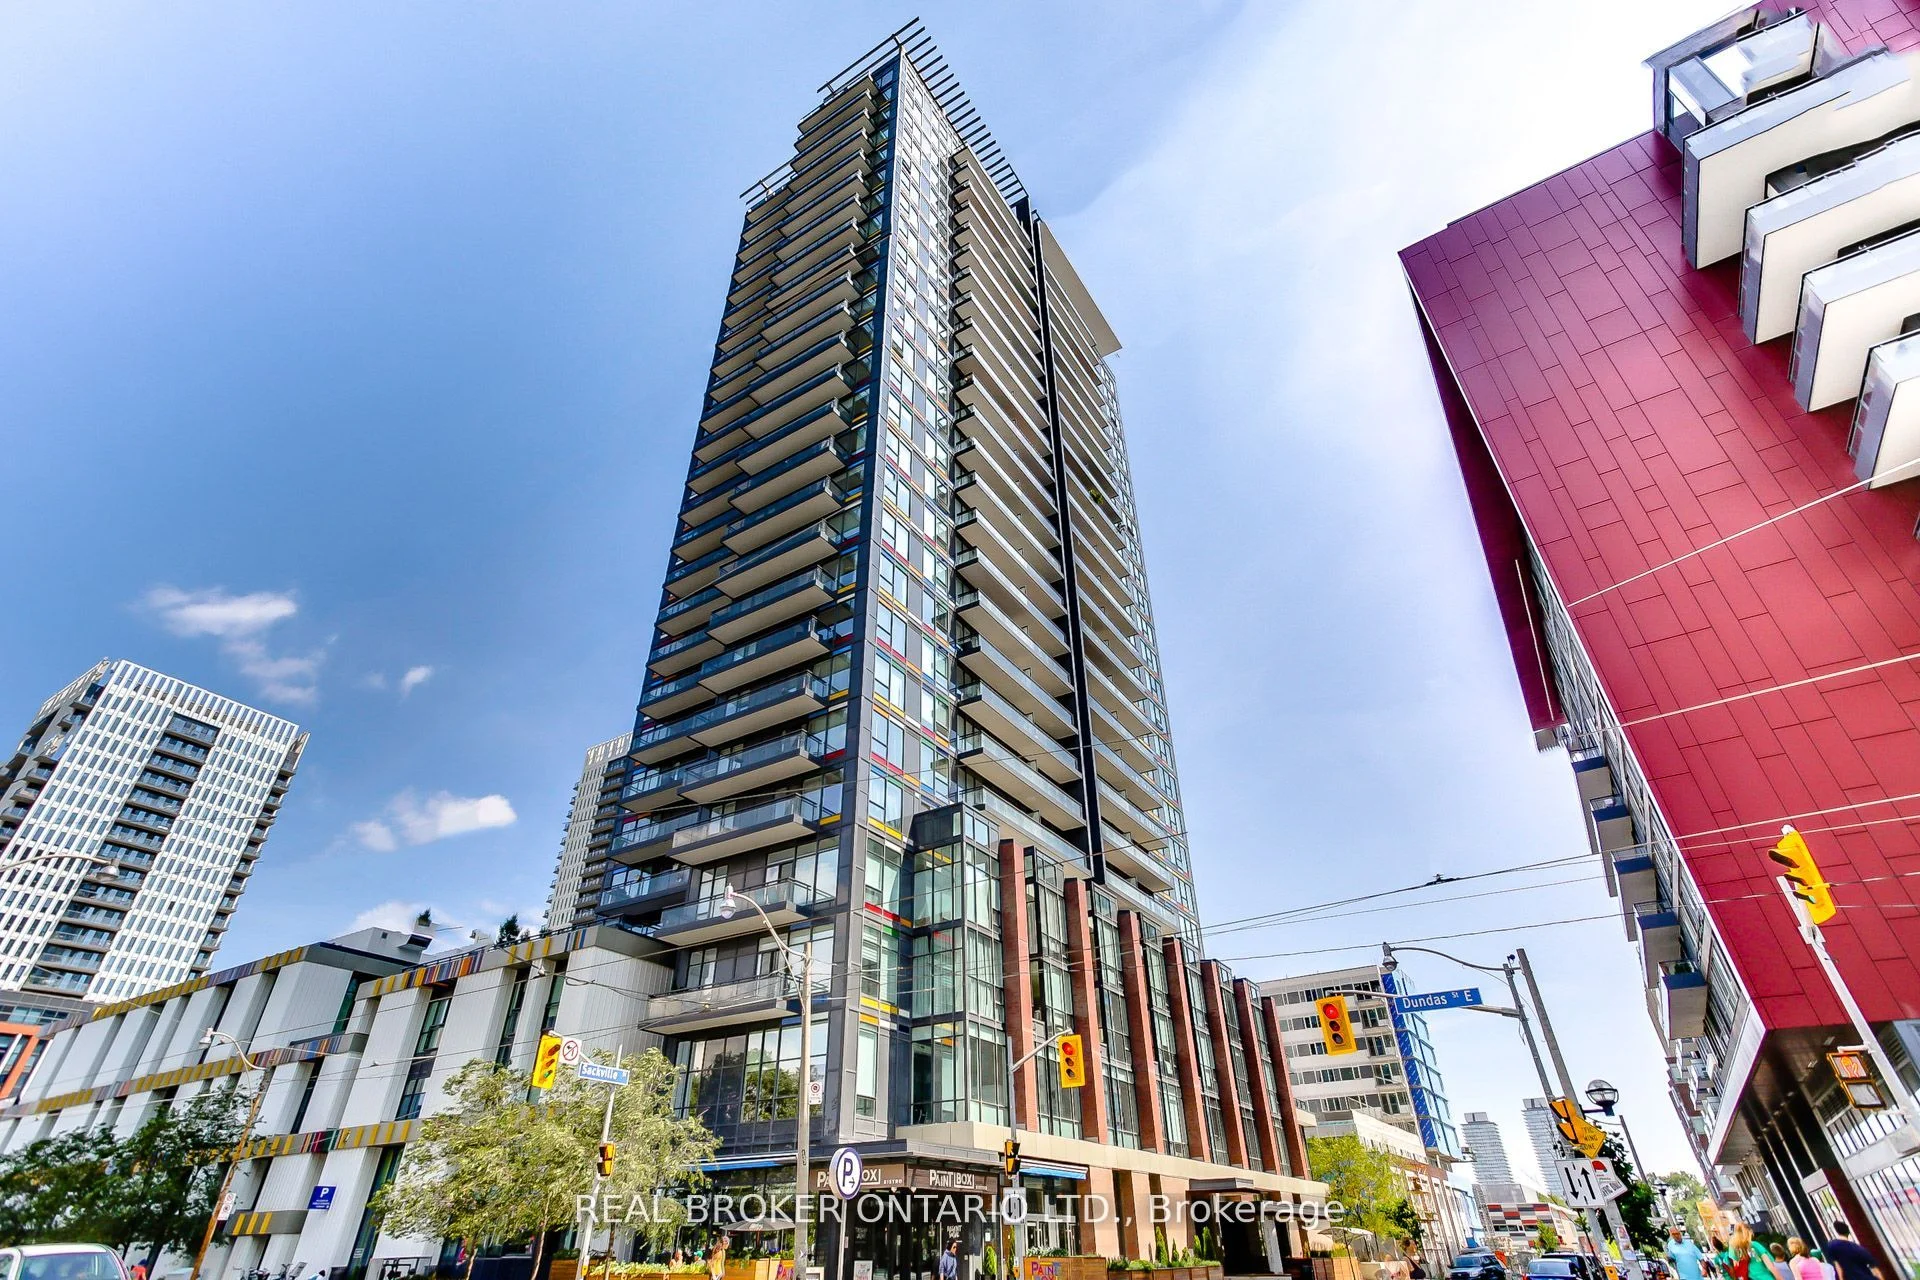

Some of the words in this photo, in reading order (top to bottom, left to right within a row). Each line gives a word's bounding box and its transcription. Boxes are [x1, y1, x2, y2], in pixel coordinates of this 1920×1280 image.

[1402, 994, 1448, 1009] Dundas
[1463, 990, 1473, 1002] E
[581, 1064, 618, 1080] Sackville
[842, 1157, 853, 1187] P
[956, 1172, 972, 1185] BOX
[319, 1187, 330, 1198] P
